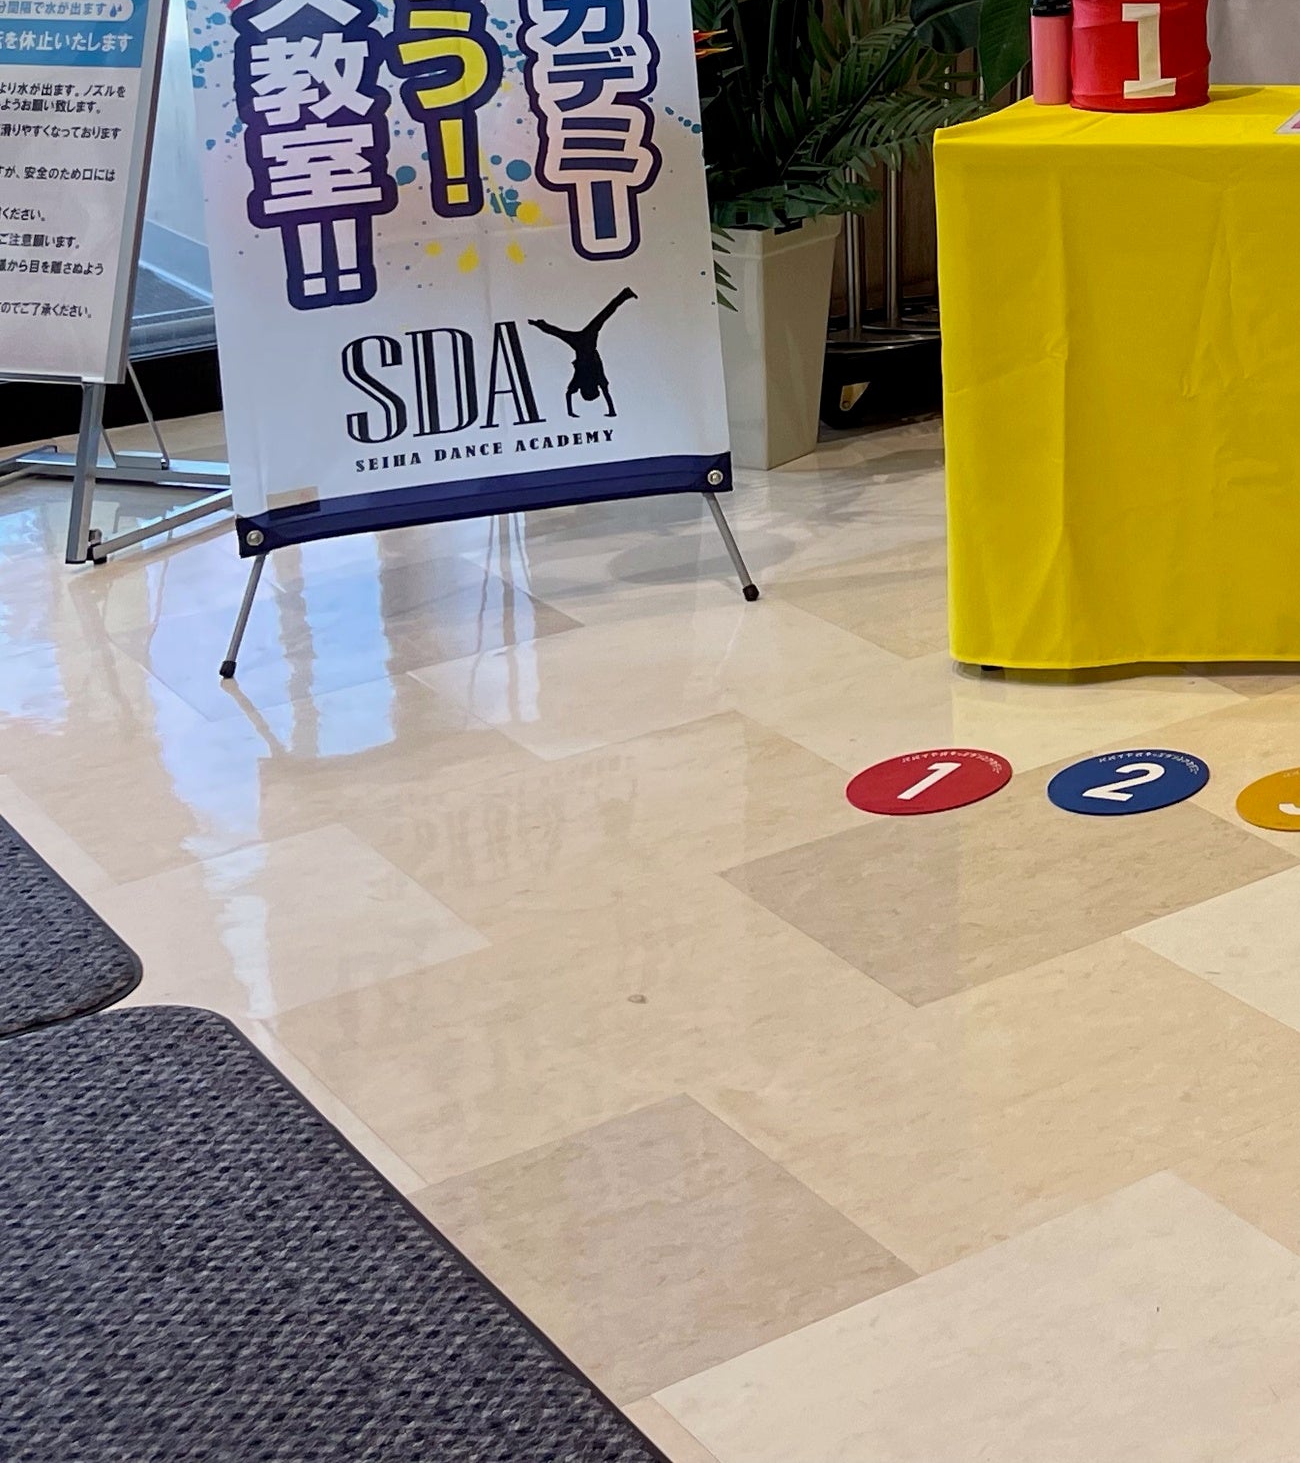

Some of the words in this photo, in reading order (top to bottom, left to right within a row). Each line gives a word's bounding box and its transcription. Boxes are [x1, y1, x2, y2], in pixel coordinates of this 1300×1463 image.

[0, 30, 134, 53] を休止いたします
[1121, 3, 1177, 100] 1
[0, 207, 45, 221] ください。
[0, 301, 91, 318] のでご了承ください。
[342, 318, 544, 446] SDA
[354, 453, 424, 474] SEIHA
[433, 441, 503, 464] DANCE
[514, 428, 617, 455] ACADEMY
[896, 761, 962, 801] 1
[1081, 761, 1166, 802] 2
